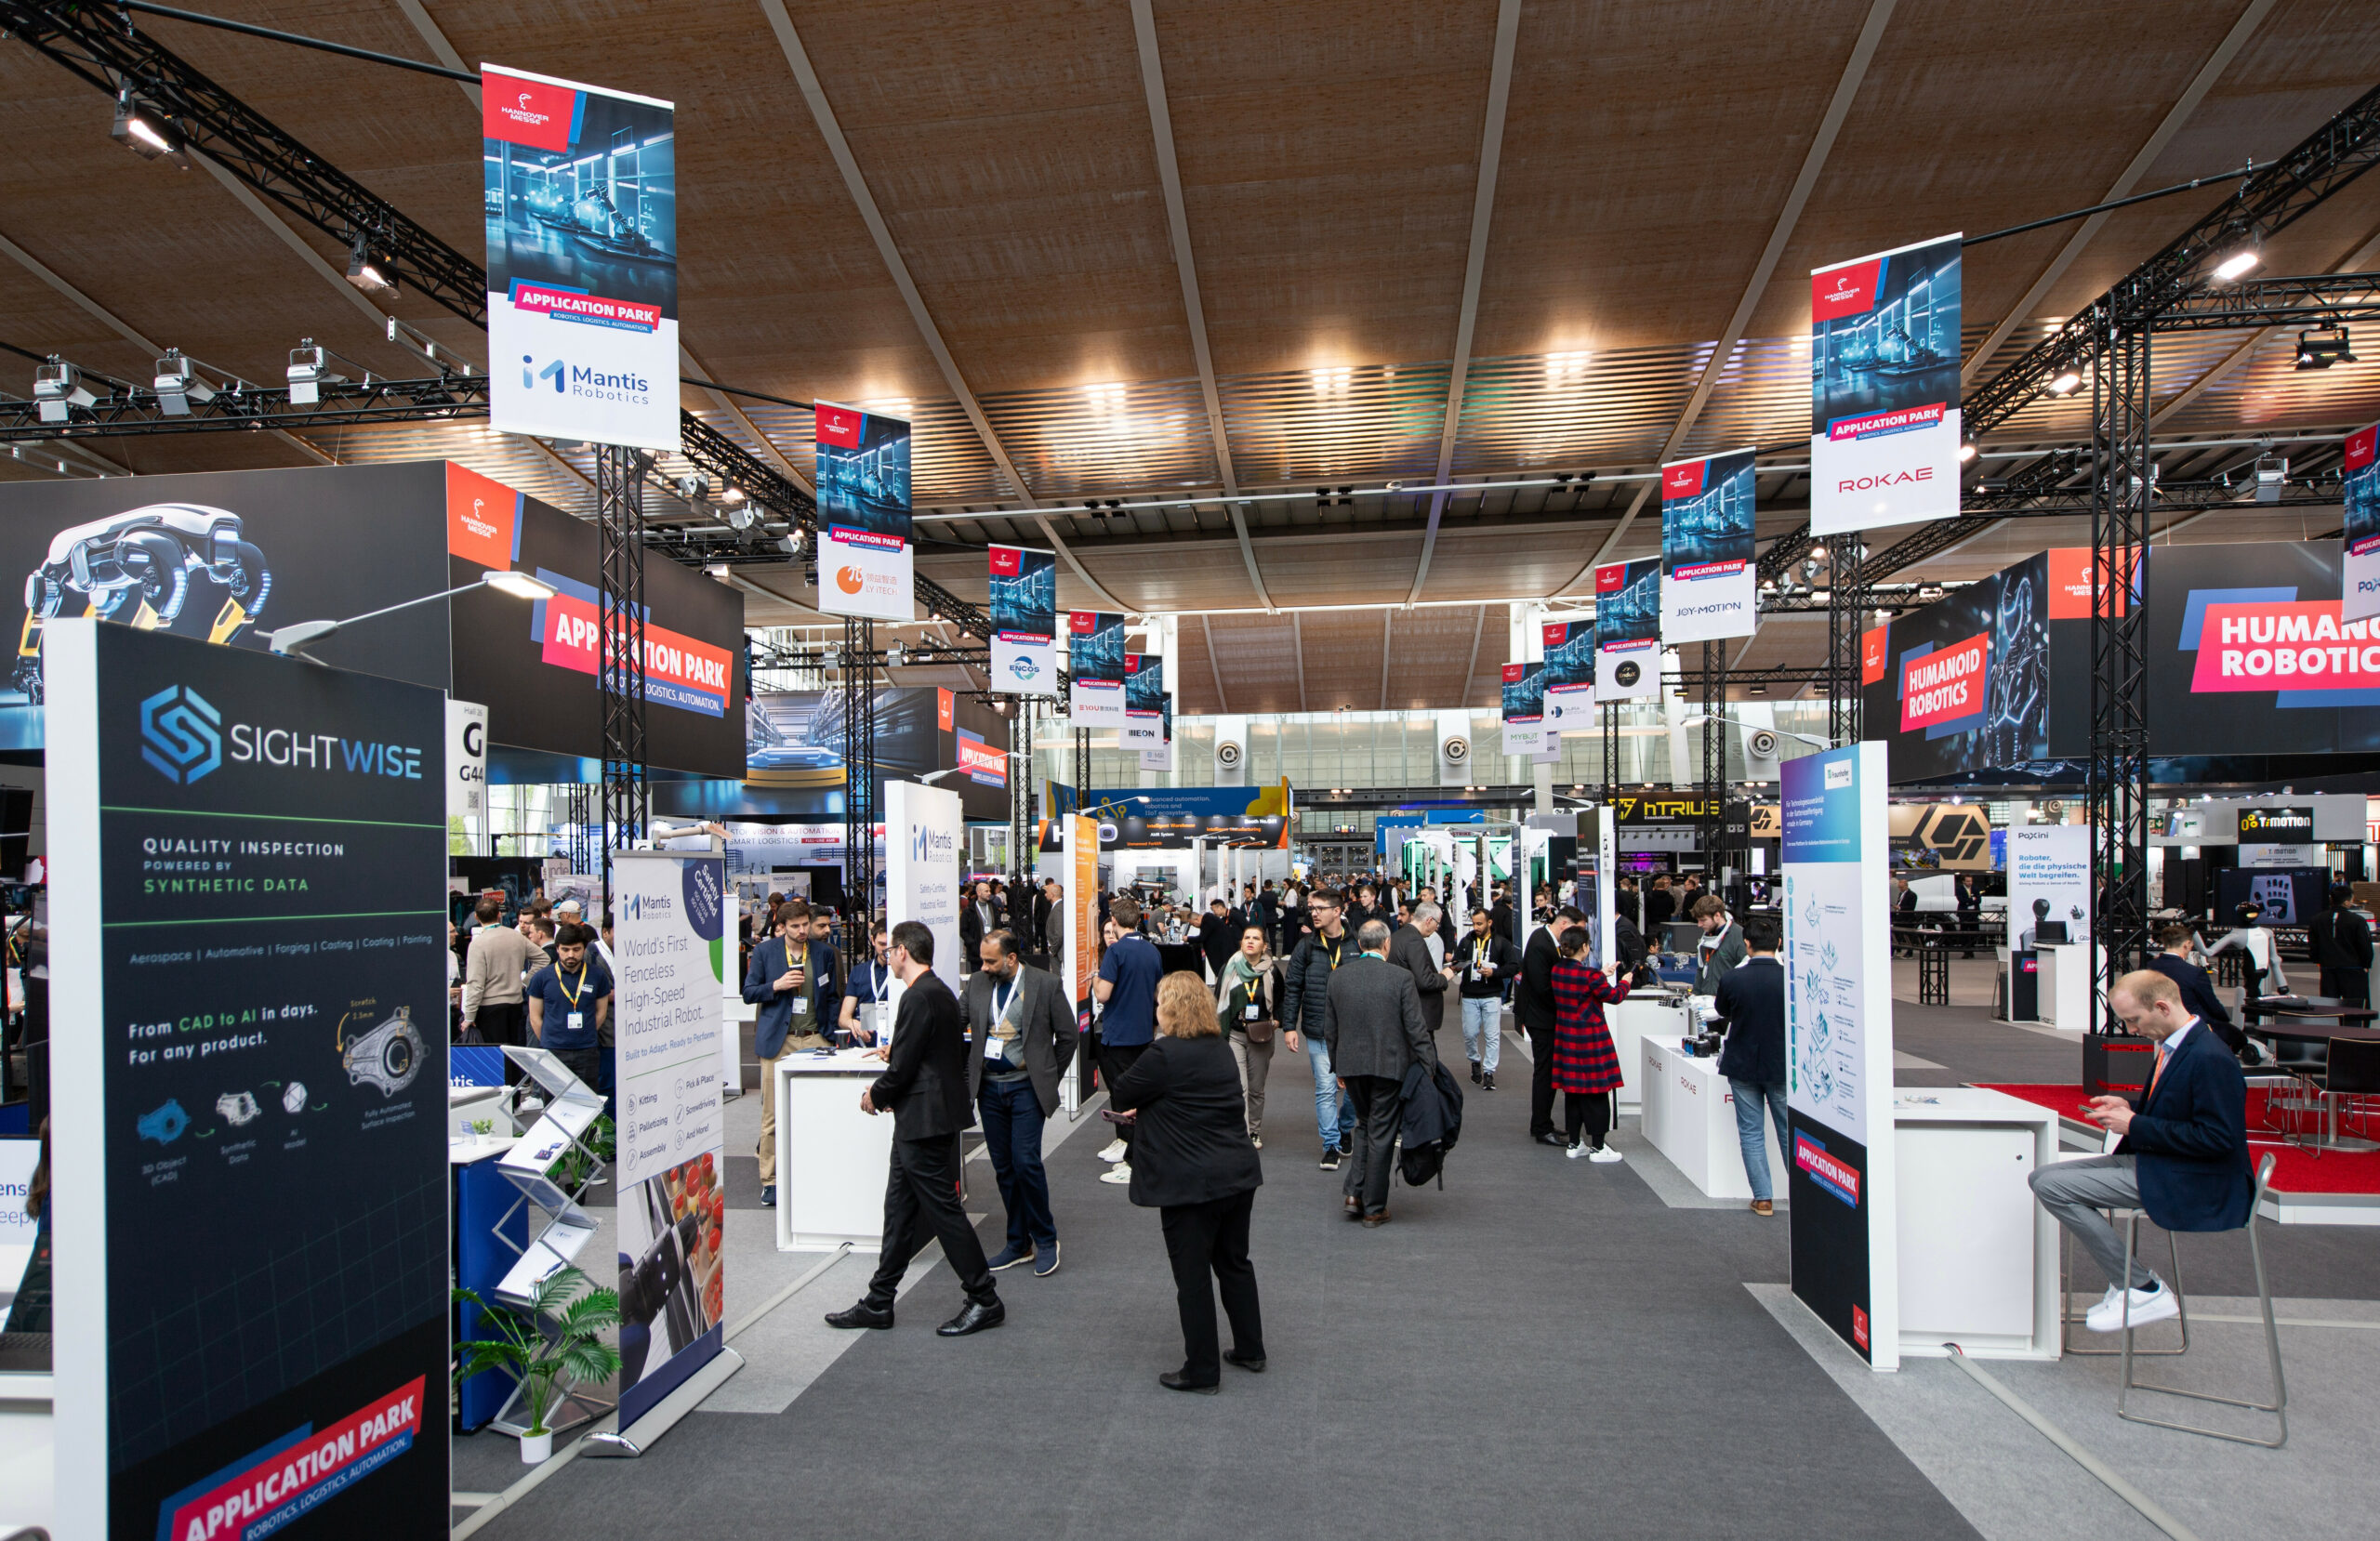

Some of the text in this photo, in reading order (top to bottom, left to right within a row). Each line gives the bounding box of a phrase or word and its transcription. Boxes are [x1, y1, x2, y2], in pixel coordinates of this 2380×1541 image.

[501, 106, 549, 122] HANNOVER
[509, 114, 541, 125] MESSE
[1824, 287, 1860, 300] HANNOVER
[1831, 293, 1854, 302] MESSE
[522, 291, 654, 323] APPLICATION PARK
[553, 311, 649, 332] ROBOTICS. LOGISTICS. AUTOMATION.
[573, 365, 648, 392] Mantis
[573, 385, 649, 405] Robotics
[1835, 408, 1939, 436] APPLICATION PARK
[1839, 467, 1933, 494] ROKAE
[461, 514, 497, 535] HANNOVER
[468, 523, 492, 538] MESSE
[835, 531, 901, 547] APPLICATION PARK
[1677, 565, 1722, 578] APPLICATION
[1723, 562, 1742, 572] PARK
[866, 586, 874, 594] LY
[1676, 600, 1741, 617] JOY-MOTION
[1002, 633, 1035, 641] APPLICATION
[1606, 639, 1652, 652] APPLICATION PARK
[685, 652, 725, 690] PARK
[1009, 665, 1040, 673] ENCOS
[1909, 648, 1980, 692] HUMANOID
[645, 683, 721, 711] OGISTICS. AUTOMATION.
[1909, 679, 1967, 718] ROBOTICS
[463, 721, 482, 757] G
[231, 724, 422, 779] SIGHTWISE
[459, 765, 483, 783] G44
[143, 837, 344, 856] QUALITY INSPECTION
[929, 829, 952, 850] Mantis
[143, 861, 231, 871] POWERED BY
[929, 850, 952, 863] Robotics
[144, 878, 310, 893] SYNTHETIC DATA
[702, 863, 720, 902] Safety
[642, 894, 671, 909] Mantis
[694, 870, 719, 917] Certified
[642, 910, 671, 920] Robotics
[130, 934, 432, 965] Aerospace Automotive Forging Casting Coating Painting
[624, 935, 688, 957] World's First
[624, 963, 675, 984] Fenceless
[625, 983, 685, 1012] High-Speed
[128, 1003, 318, 1039] From CAD to AI in days.
[626, 1005, 704, 1037] Industrial Robot.
[128, 1031, 268, 1066] For any product.
[625, 1049, 640, 1061] Built
[641, 1047, 648, 1057] to
[649, 1043, 668, 1055] Adapt.
[669, 1037, 686, 1049] Ready
[687, 1035, 693, 1045] to
[1648, 1056, 1662, 1072] ROKAE
[686, 1080, 694, 1090] Pick
[701, 1074, 715, 1085] Place
[1681, 1075, 1697, 1095] ROKAE
[639, 1093, 658, 1107] Kitting
[685, 1098, 716, 1115] Screwdriving
[639, 1116, 668, 1133] Palletizing
[686, 1130, 695, 1141] And
[639, 1142, 667, 1160] Assembly
[1799, 1145, 1857, 1192] APPLICATION PARK
[185, 1395, 416, 1541] APPLICATION PARK
[246, 1437, 407, 1541] ROBOTICS. LOGISTICS. AUTOMATION.
